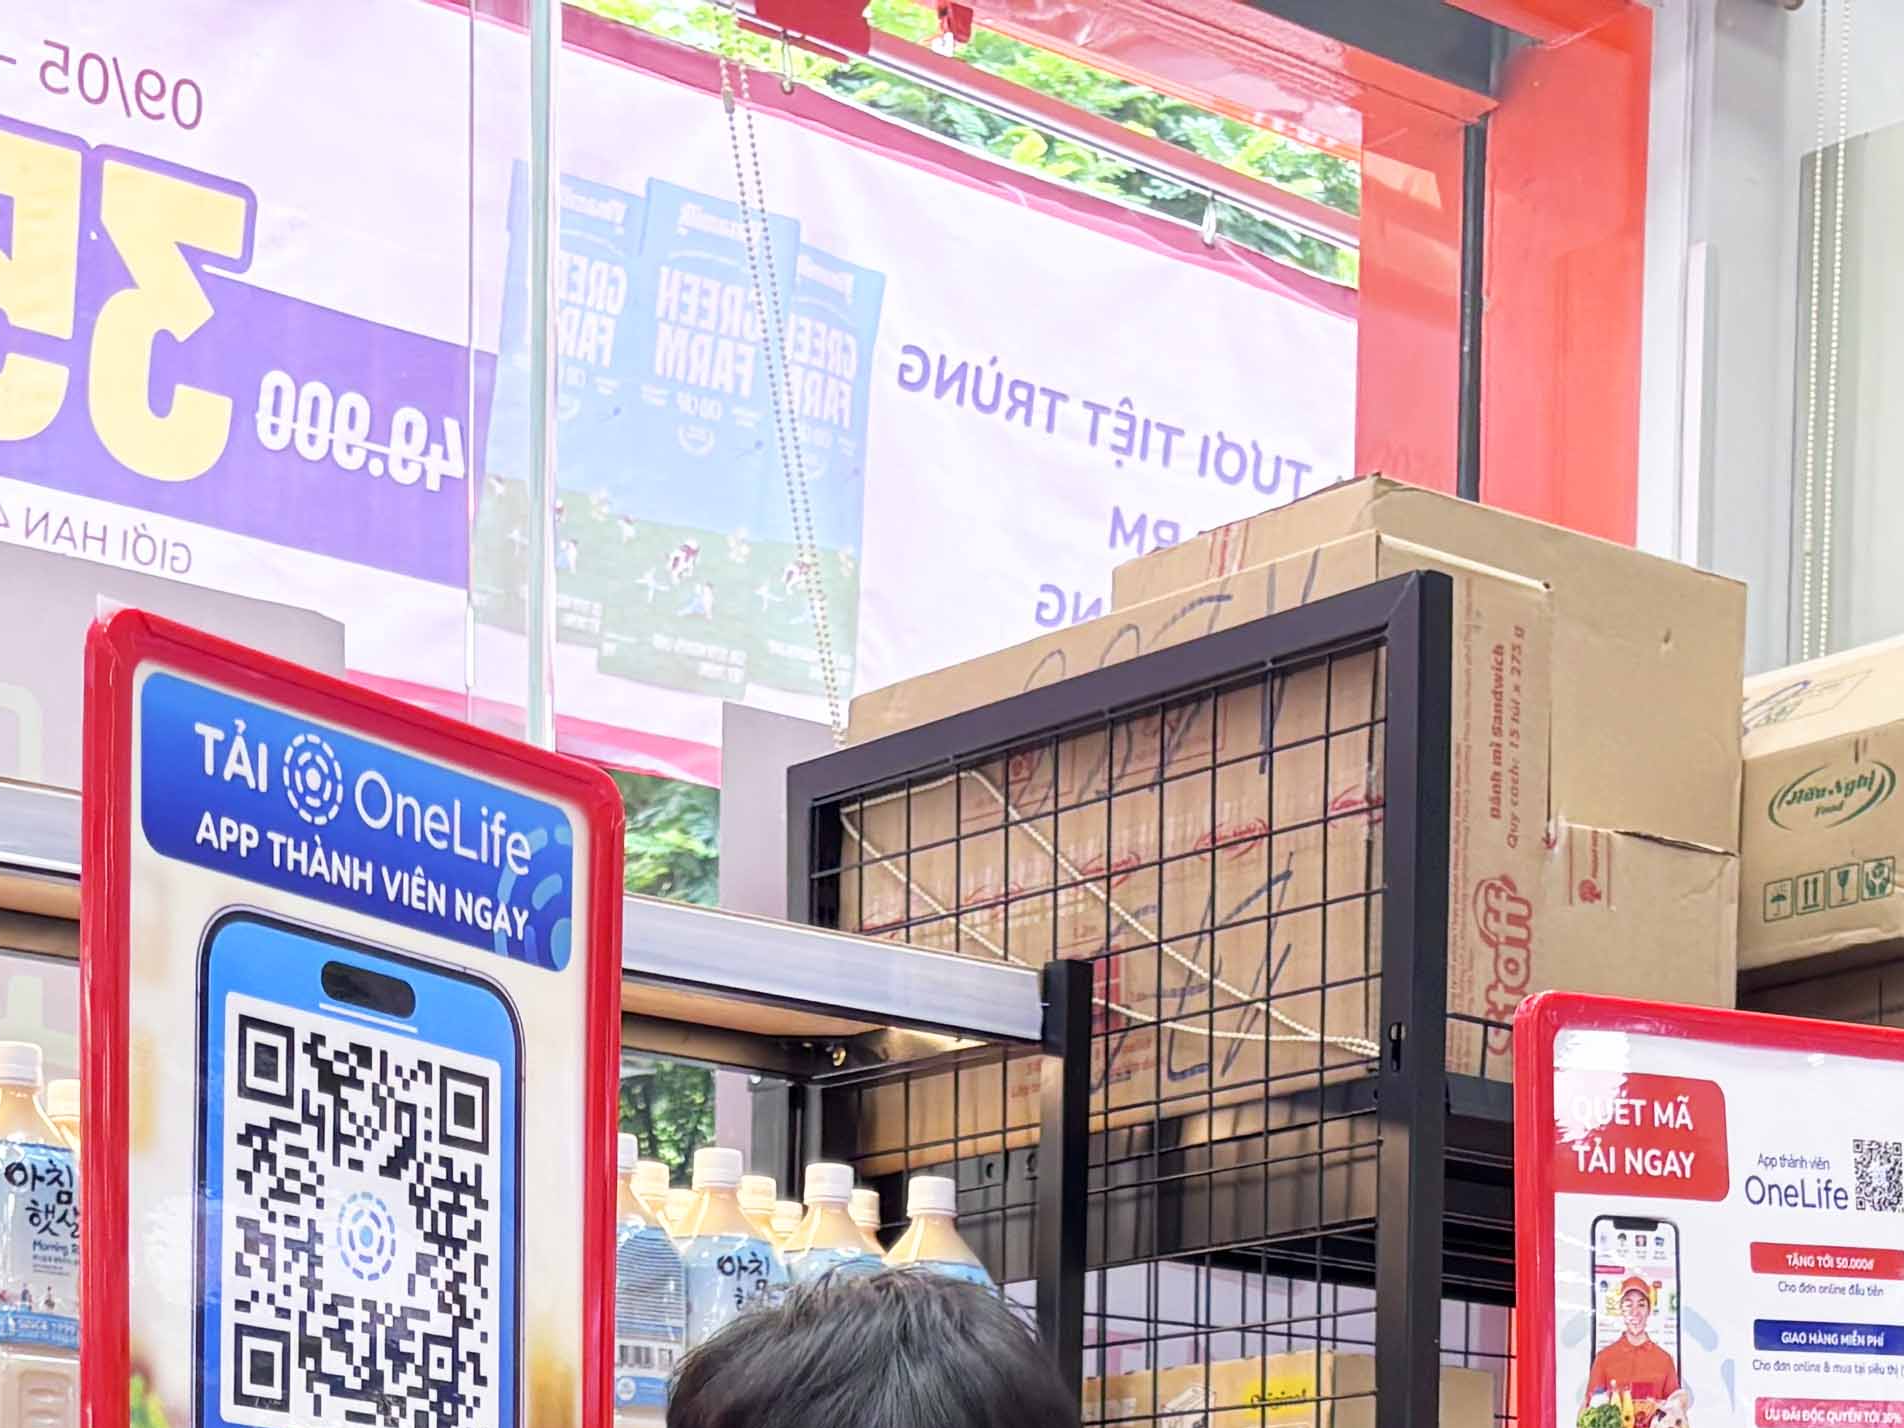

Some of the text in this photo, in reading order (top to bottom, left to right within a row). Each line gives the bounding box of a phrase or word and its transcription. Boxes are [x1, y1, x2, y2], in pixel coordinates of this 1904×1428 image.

[195, 720, 532, 876] TẢI OneLife
[196, 811, 529, 942] APP THÀNH VIÊN NGAY
[1653, 1096, 1693, 1130] MÃ
[1572, 1138, 1694, 1178] TẢI NGAY
[1745, 1175, 1849, 1210] OneLife
